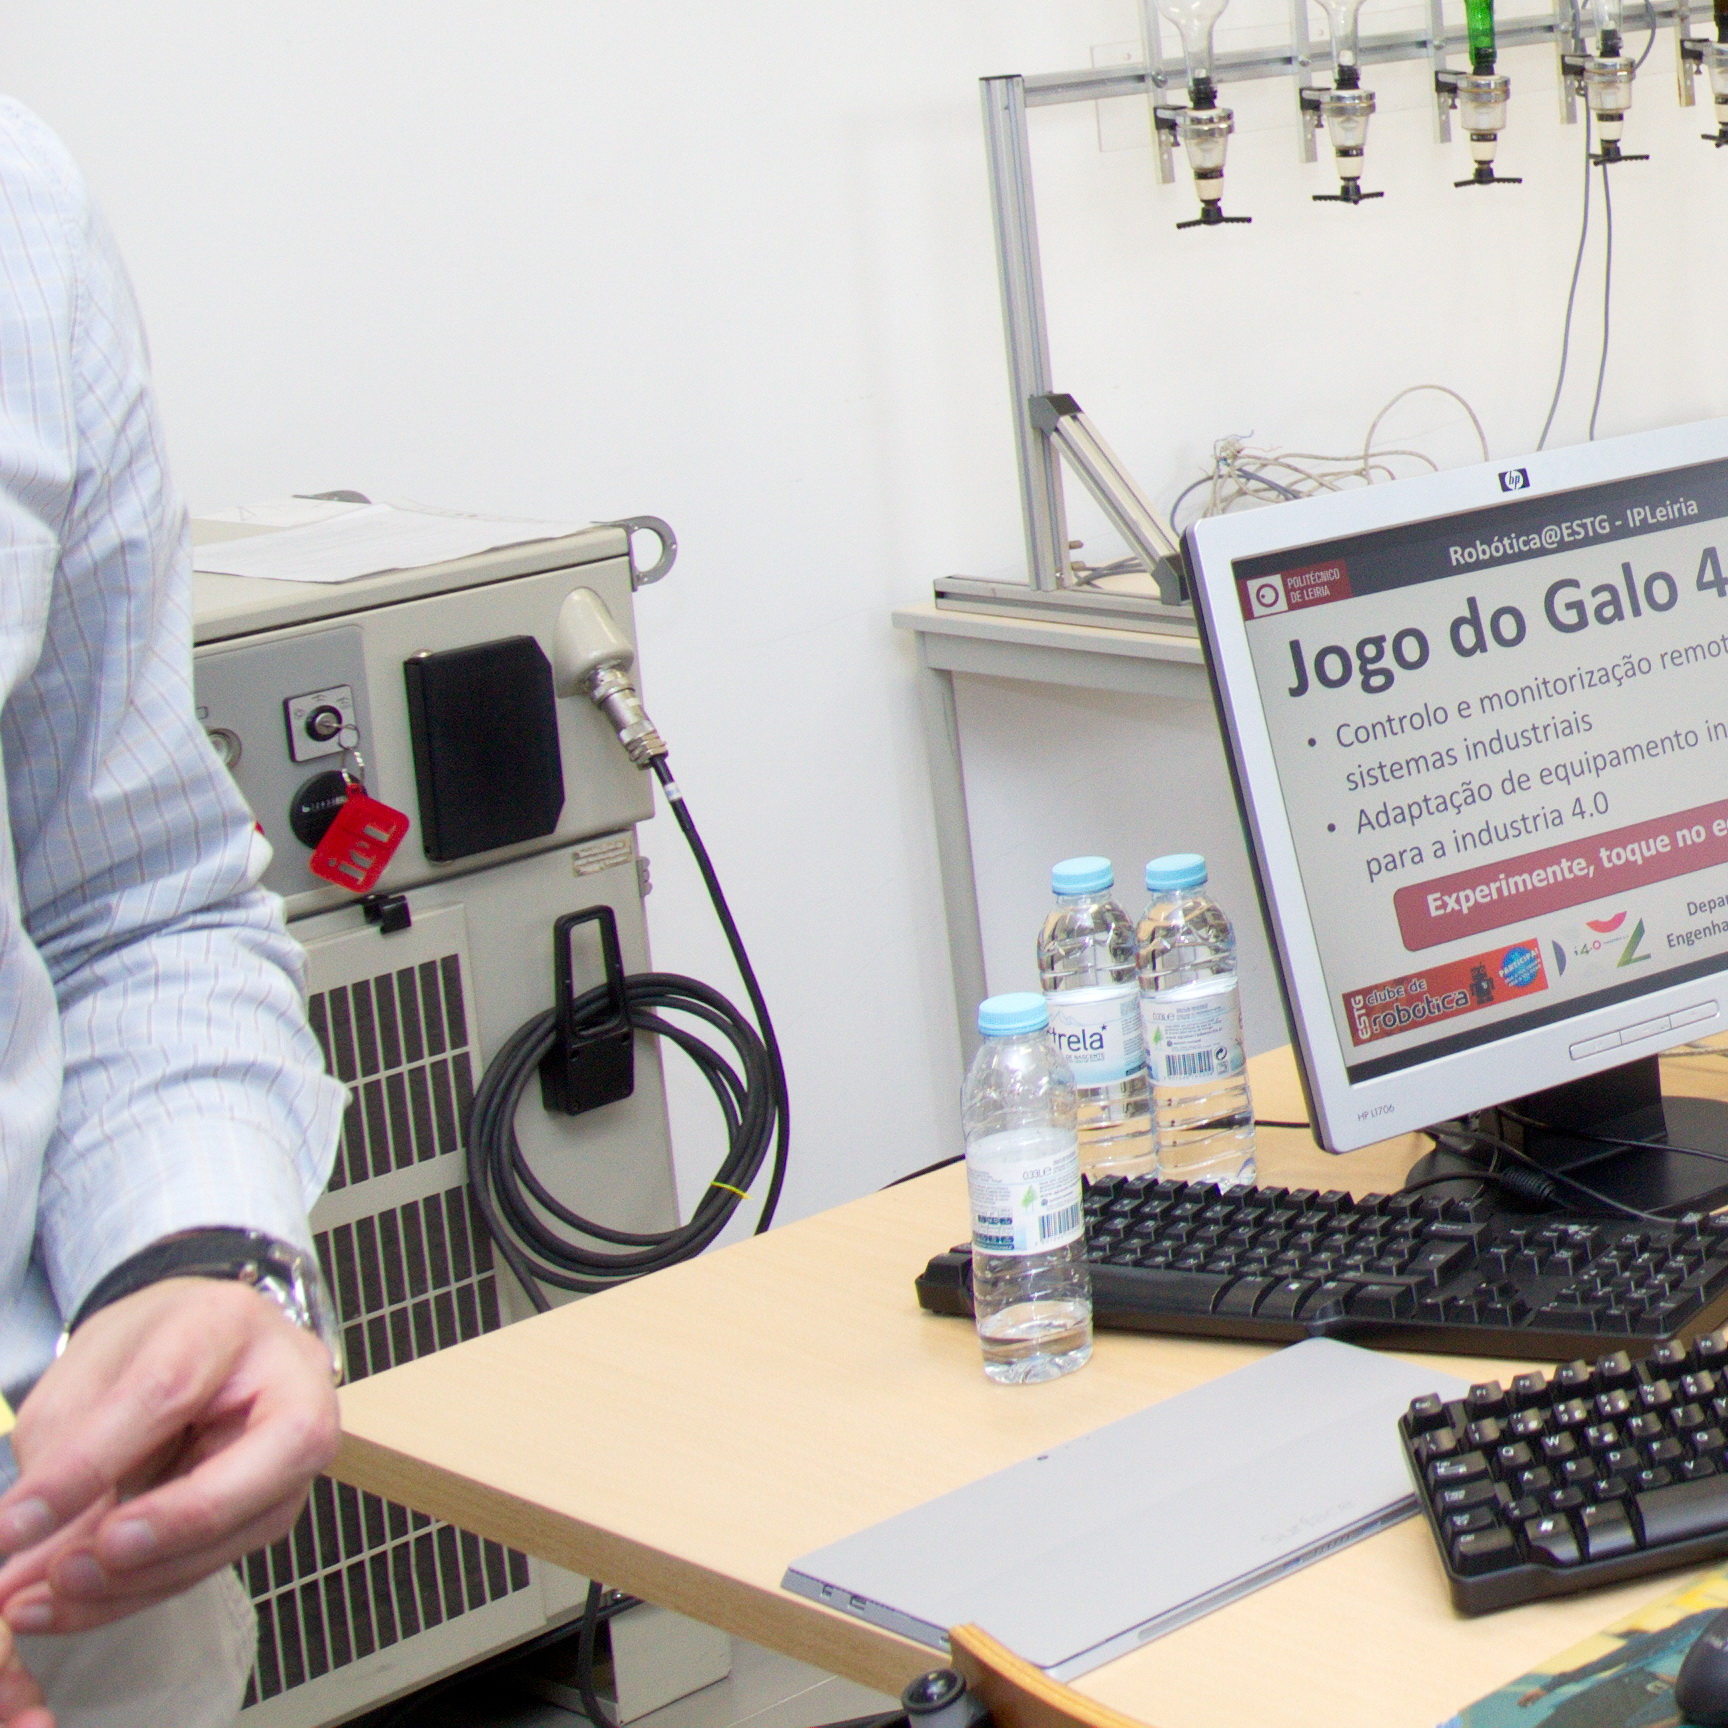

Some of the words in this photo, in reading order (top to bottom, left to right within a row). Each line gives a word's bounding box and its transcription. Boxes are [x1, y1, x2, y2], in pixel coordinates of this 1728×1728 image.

[1449, 514, 1611, 567] Robótica@ESTG
[1626, 497, 1699, 529] IPLeiria
[1286, 567, 1341, 590] POLITÉCNICO
[1290, 590, 1303, 604] DE
[1303, 584, 1331, 601] LEIRIA
[1288, 626, 1430, 698] Jogo
[1449, 595, 1527, 659] do
[1543, 561, 1679, 635] Galo
[1336, 702, 1449, 748] Controlo
[1457, 700, 1473, 719] e
[1479, 654, 1652, 714] monitorização
[1345, 746, 1459, 792] sistemas
[1463, 710, 1594, 762] industriais
[1356, 780, 1493, 835] Adaptação
[1500, 769, 1532, 796] de
[1539, 728, 1699, 786] equipamento
[1365, 845, 1424, 883] para
[1432, 839, 1447, 860] a
[1453, 806, 1564, 854] industria
[1571, 790, 1610, 820] 4.0
[1426, 855, 1595, 918] Experimente,
[1599, 833, 1671, 870] toque
[1676, 824, 1706, 848] no
[1366, 983, 1406, 1008] clube
[1408, 978, 1427, 995] de
[1498, 947, 1541, 979] PARTICIPA!
[1047, 1026, 1105, 1052] trela
[1357, 1110, 1370, 1122] HP
